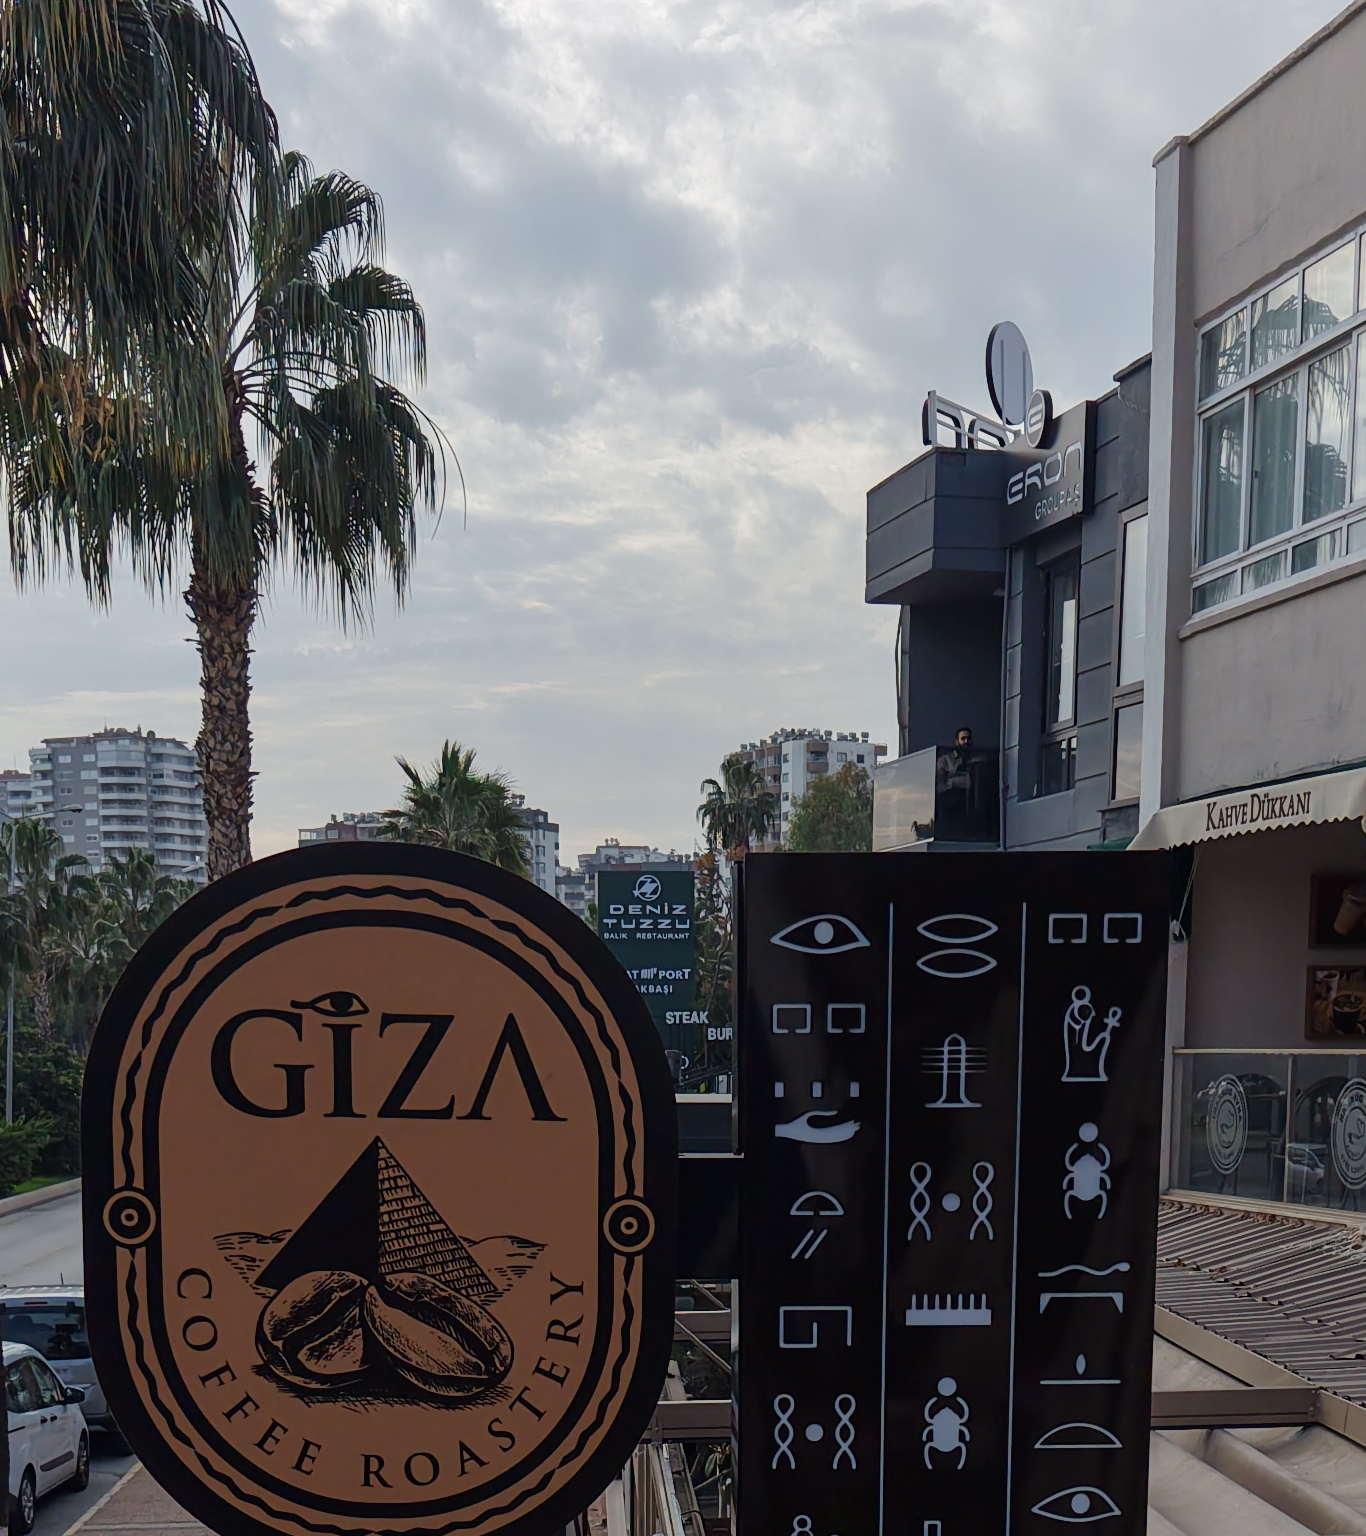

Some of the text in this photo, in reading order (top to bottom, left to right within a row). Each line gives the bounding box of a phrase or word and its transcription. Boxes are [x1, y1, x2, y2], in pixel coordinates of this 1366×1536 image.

[1205, 791, 1311, 831] KAHVE DÜKKANI
[609, 902, 687, 915] DENİZ
[603, 918, 690, 929] TUZZU
[603, 932, 690, 940] BALIK RESTAURANT
[658, 968, 692, 980] PORT
[665, 1011, 709, 1025] STEAK
[177, 1267, 586, 1490] COFFEE ROASTERY
